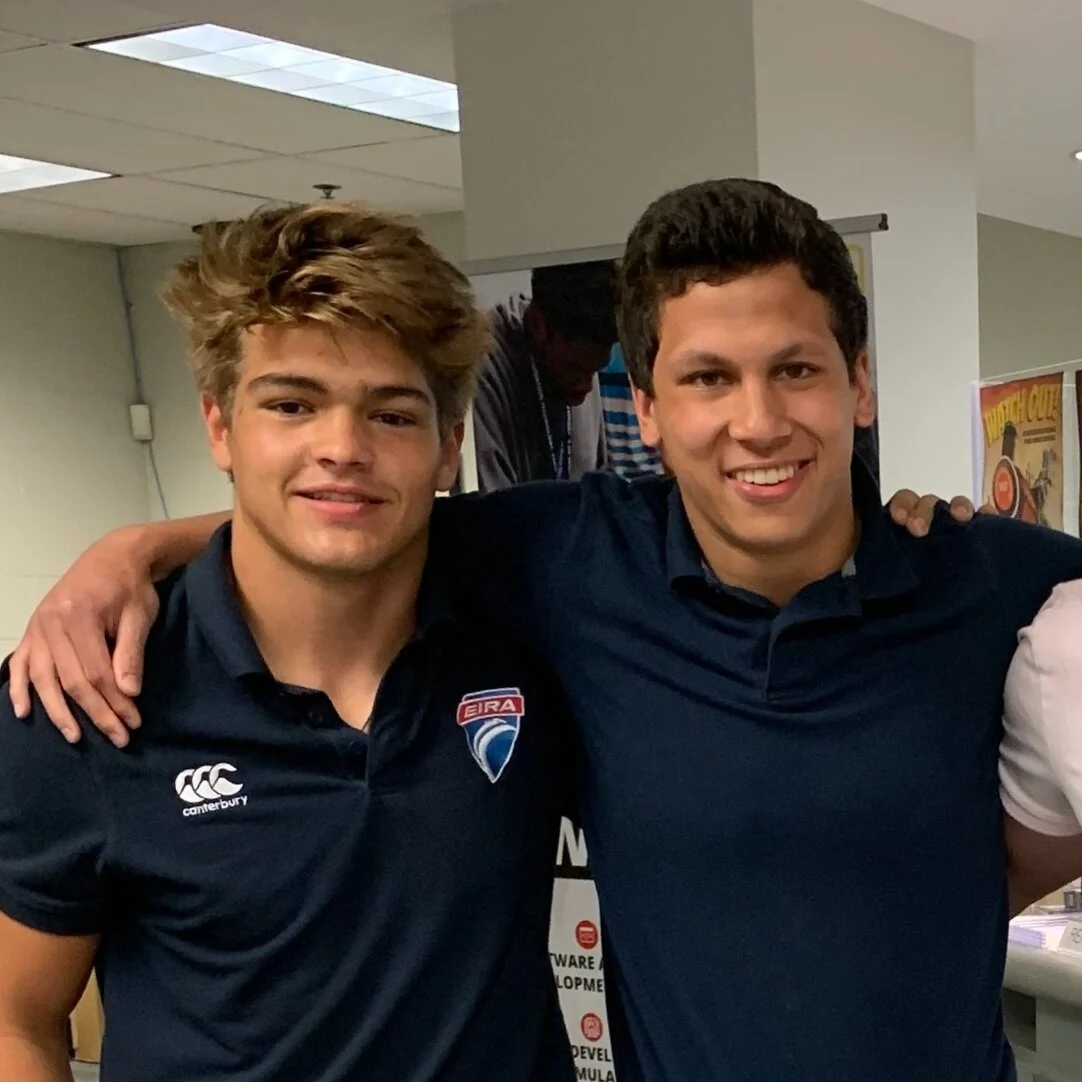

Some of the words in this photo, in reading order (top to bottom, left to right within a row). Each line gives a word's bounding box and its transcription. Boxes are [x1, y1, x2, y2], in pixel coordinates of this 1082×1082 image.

[984, 386, 1028, 446] WATCH
[464, 699, 516, 719] EIRA
[182, 794, 249, 818] canterbury
